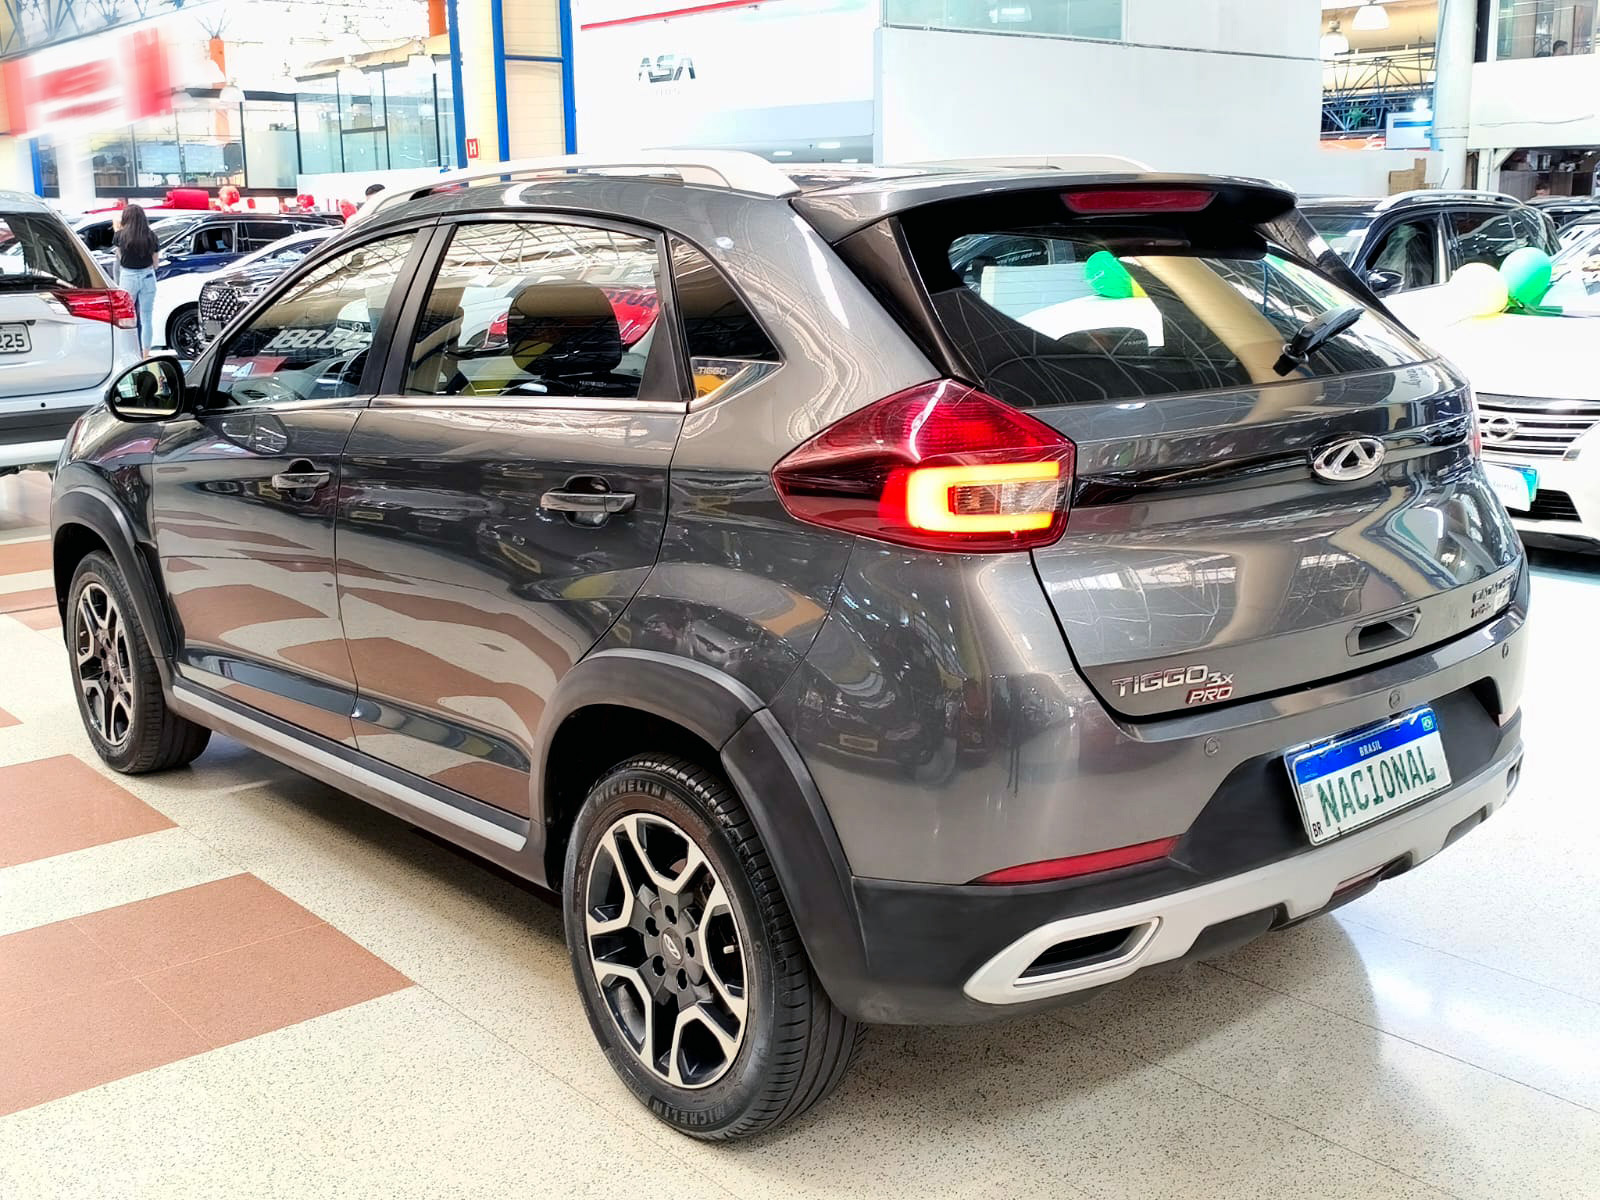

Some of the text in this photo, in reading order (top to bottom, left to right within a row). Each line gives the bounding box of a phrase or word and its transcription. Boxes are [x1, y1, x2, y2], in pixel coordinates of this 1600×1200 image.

[638, 54, 696, 83] ASA
[0, 333, 25, 349] 25
[1186, 685, 1233, 705] PRO
[1358, 739, 1383, 757] BRASIL
[595, 779, 662, 805] MICHELIN
[1316, 745, 1437, 827] NACIONAL
[1312, 821, 1324, 837] BR
[651, 1099, 727, 1126] MICHELIN
